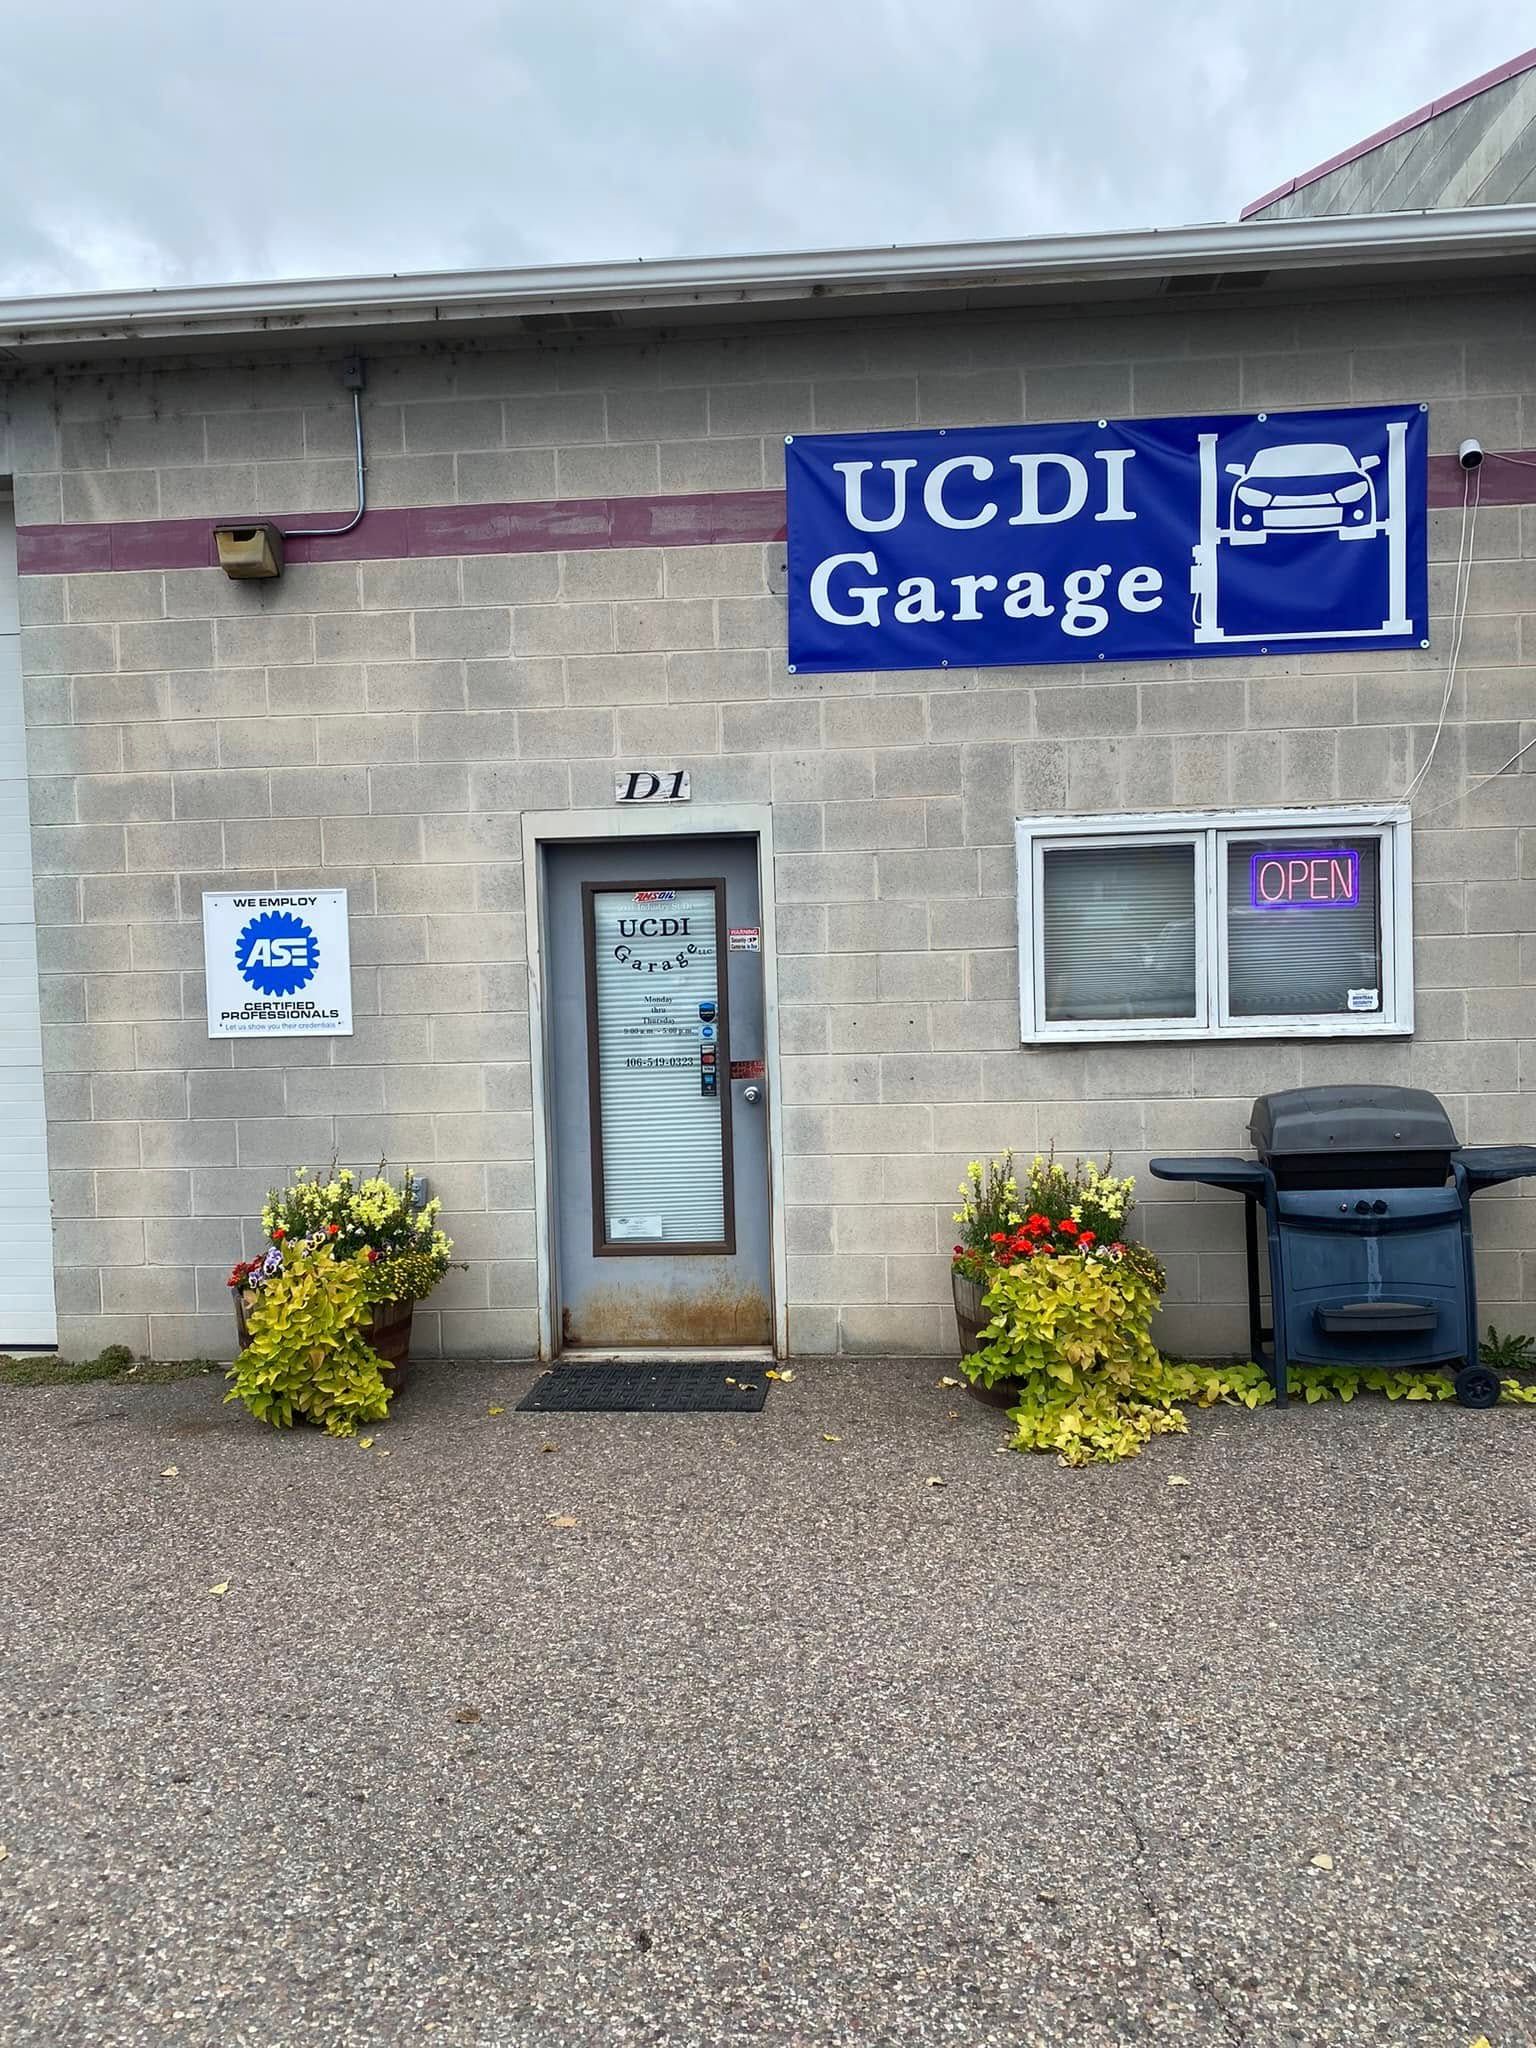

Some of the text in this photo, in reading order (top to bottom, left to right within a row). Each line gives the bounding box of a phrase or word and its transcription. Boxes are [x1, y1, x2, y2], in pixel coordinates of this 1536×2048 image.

[833, 449, 1137, 533] UCDI
[809, 551, 1164, 637] Garage
[620, 770, 685, 800] D1
[1260, 858, 1353, 901] OPEN
[233, 897, 318, 908] WE EMPLOY
[634, 891, 675, 902] AMSOIL
[617, 917, 691, 938] UCDI
[245, 937, 309, 968] ASE
[614, 944, 698, 973] Garage
[244, 1001, 315, 1011] CERTIFIED
[643, 996, 673, 1004] Monday
[221, 1009, 339, 1020] PROFESSIONALS
[641, 1016, 675, 1024] Thursday
[225, 1023, 237, 1031] Let
[267, 1023, 280, 1031] you
[299, 1020, 336, 1029] credentials
